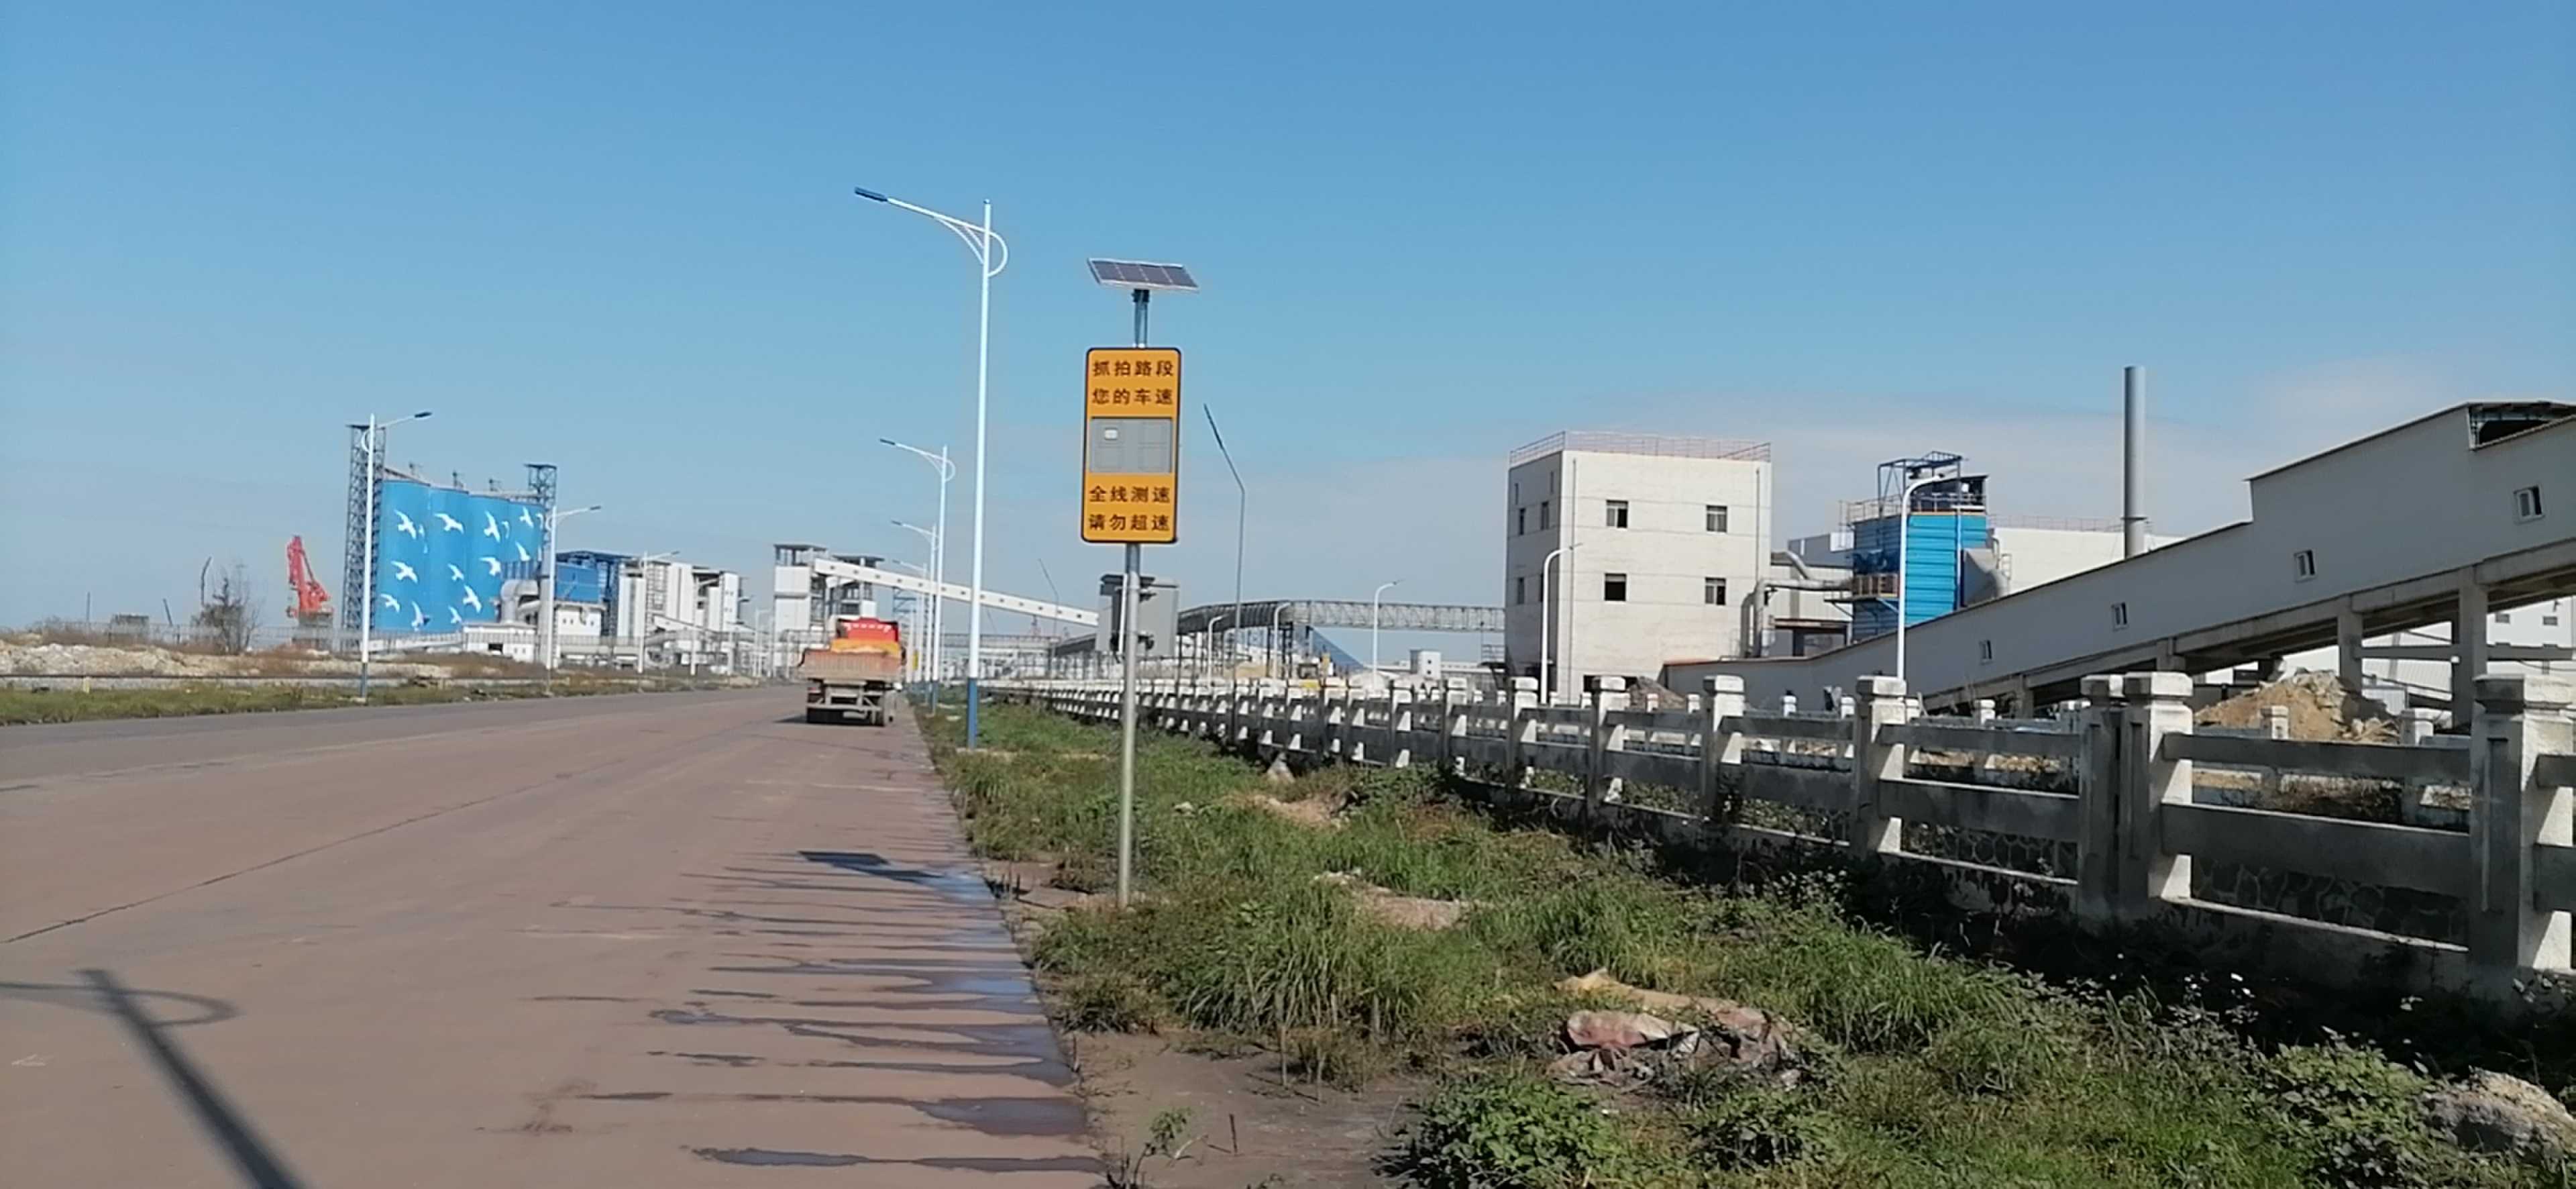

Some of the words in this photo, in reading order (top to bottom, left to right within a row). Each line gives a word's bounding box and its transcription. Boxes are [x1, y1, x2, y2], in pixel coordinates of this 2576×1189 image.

[1093, 360, 1174, 376] 抓拍路段
[1092, 389, 1173, 405] 您的车速
[1089, 486, 1170, 503] 全线测速
[1088, 514, 1170, 531] 请勿超速
